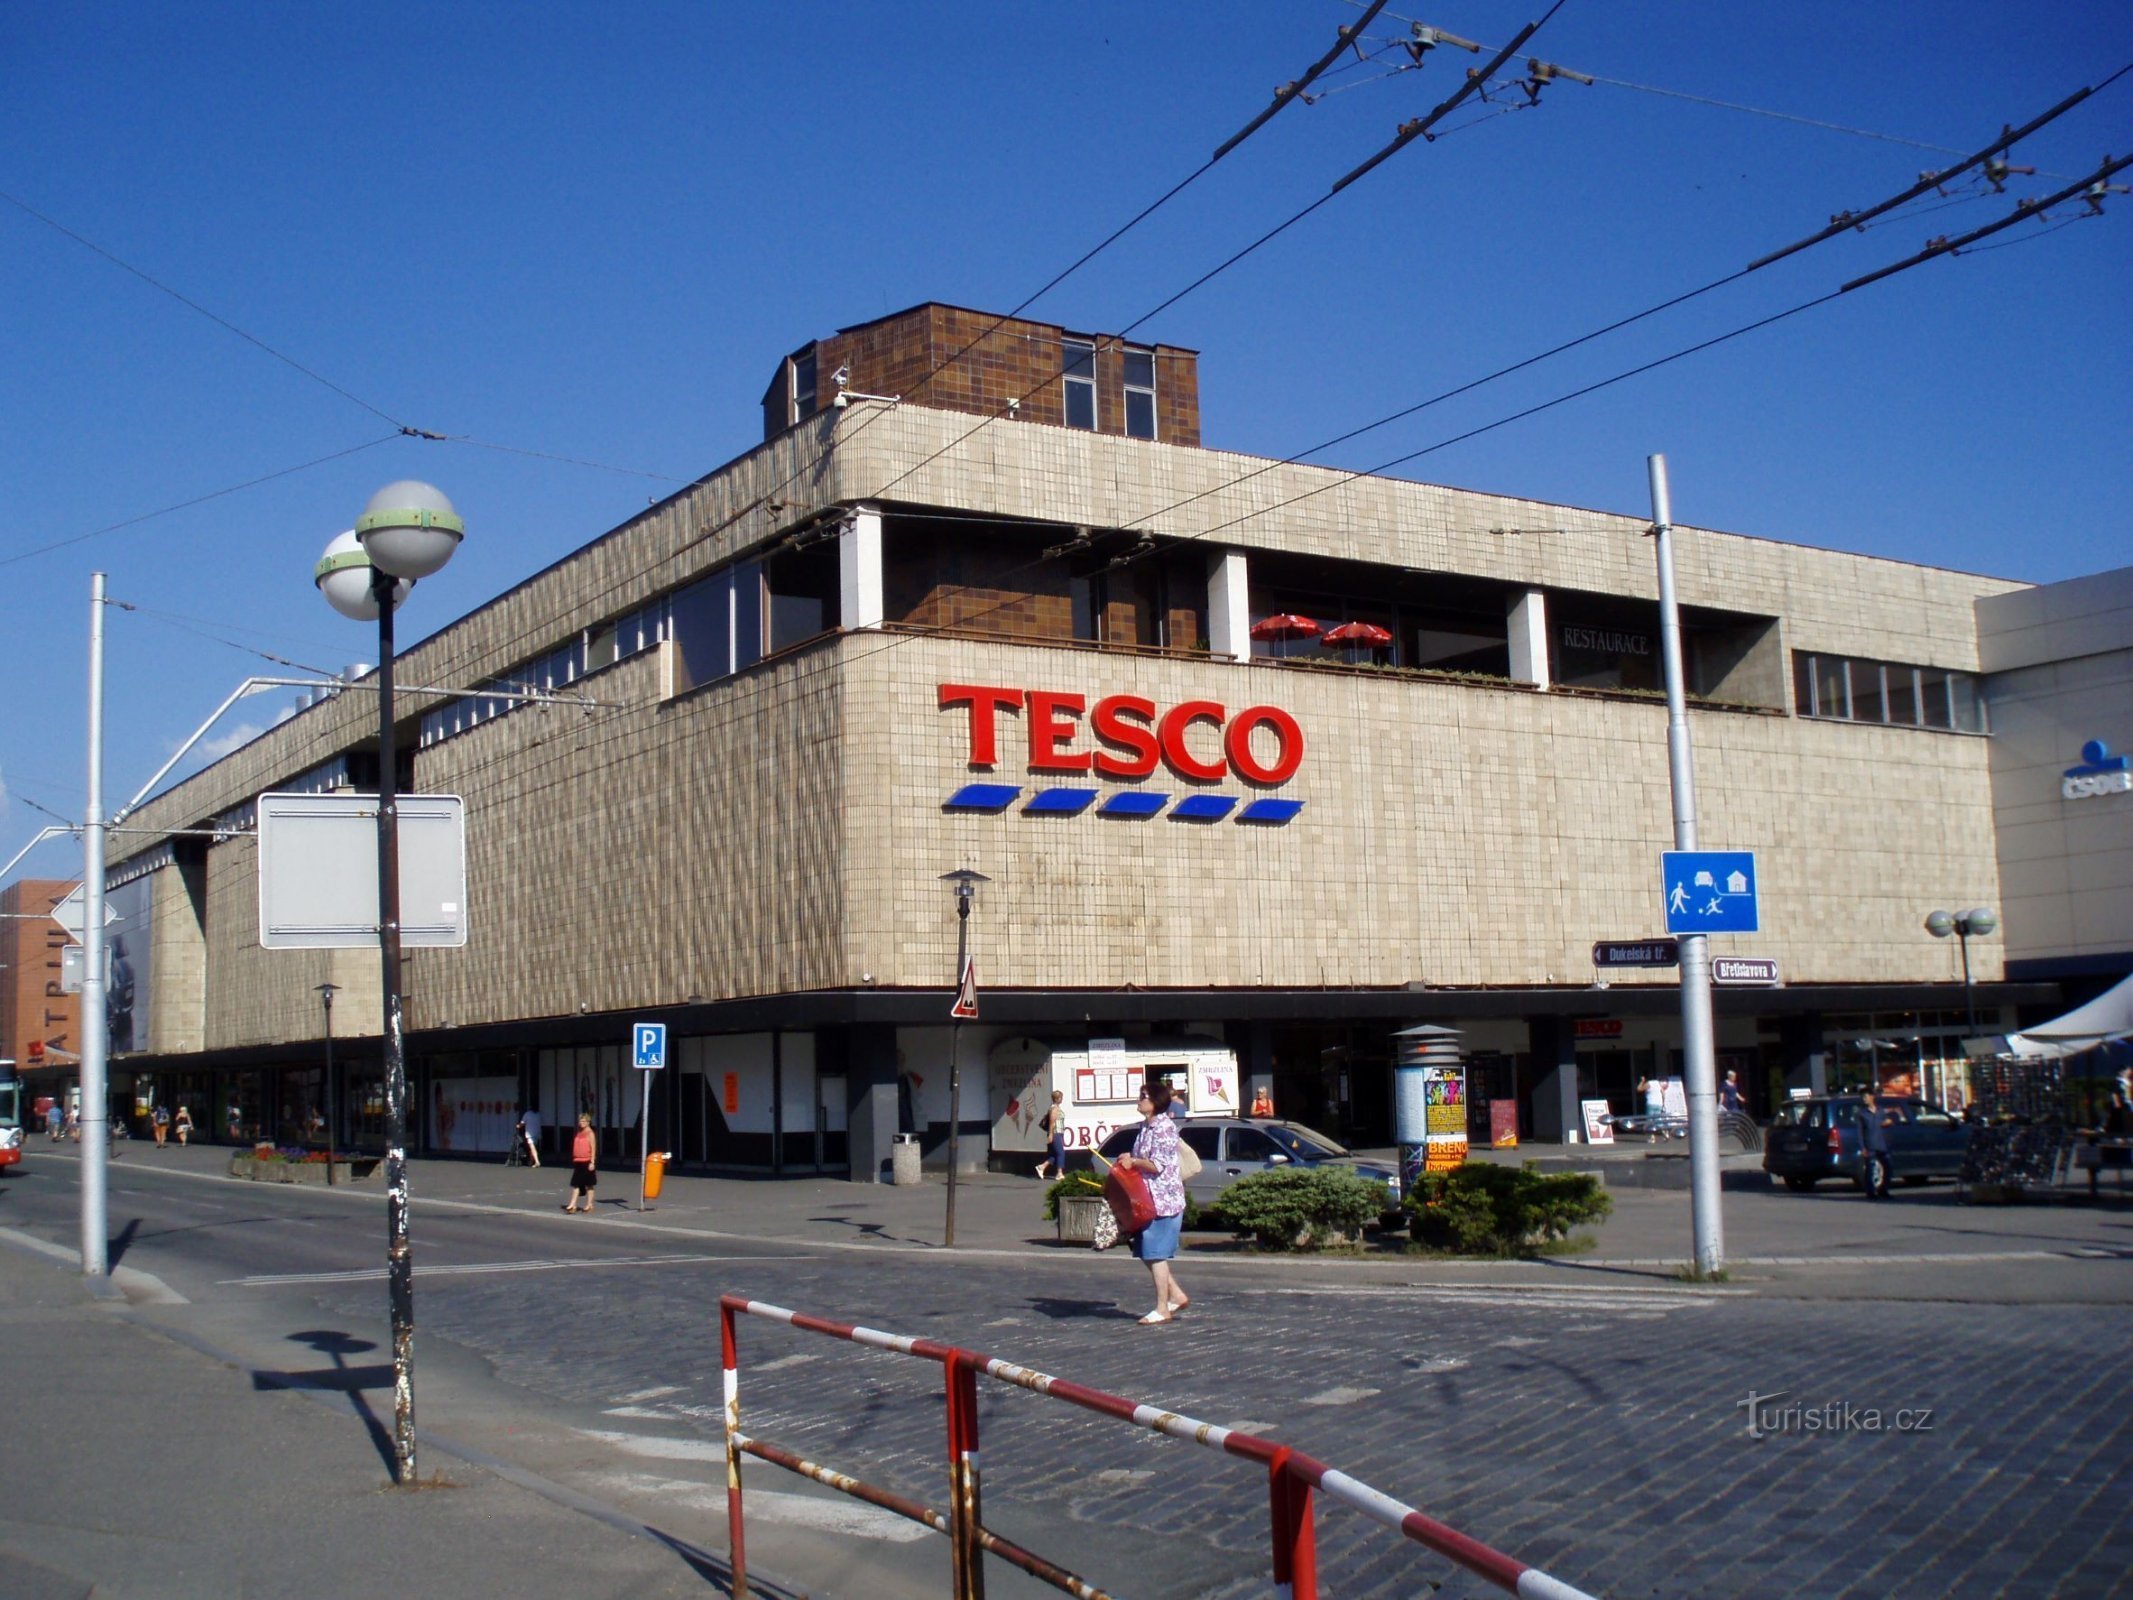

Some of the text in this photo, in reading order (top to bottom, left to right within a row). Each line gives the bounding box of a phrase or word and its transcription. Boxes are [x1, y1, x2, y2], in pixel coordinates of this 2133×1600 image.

[1563, 627, 1649, 655] RESTAURACE
[937, 683, 1304, 784] TESCO
[1609, 945, 1668, 961] Dukelská tř.
[1720, 962, 1768, 978] Břetislavova
[641, 1029, 657, 1053] P
